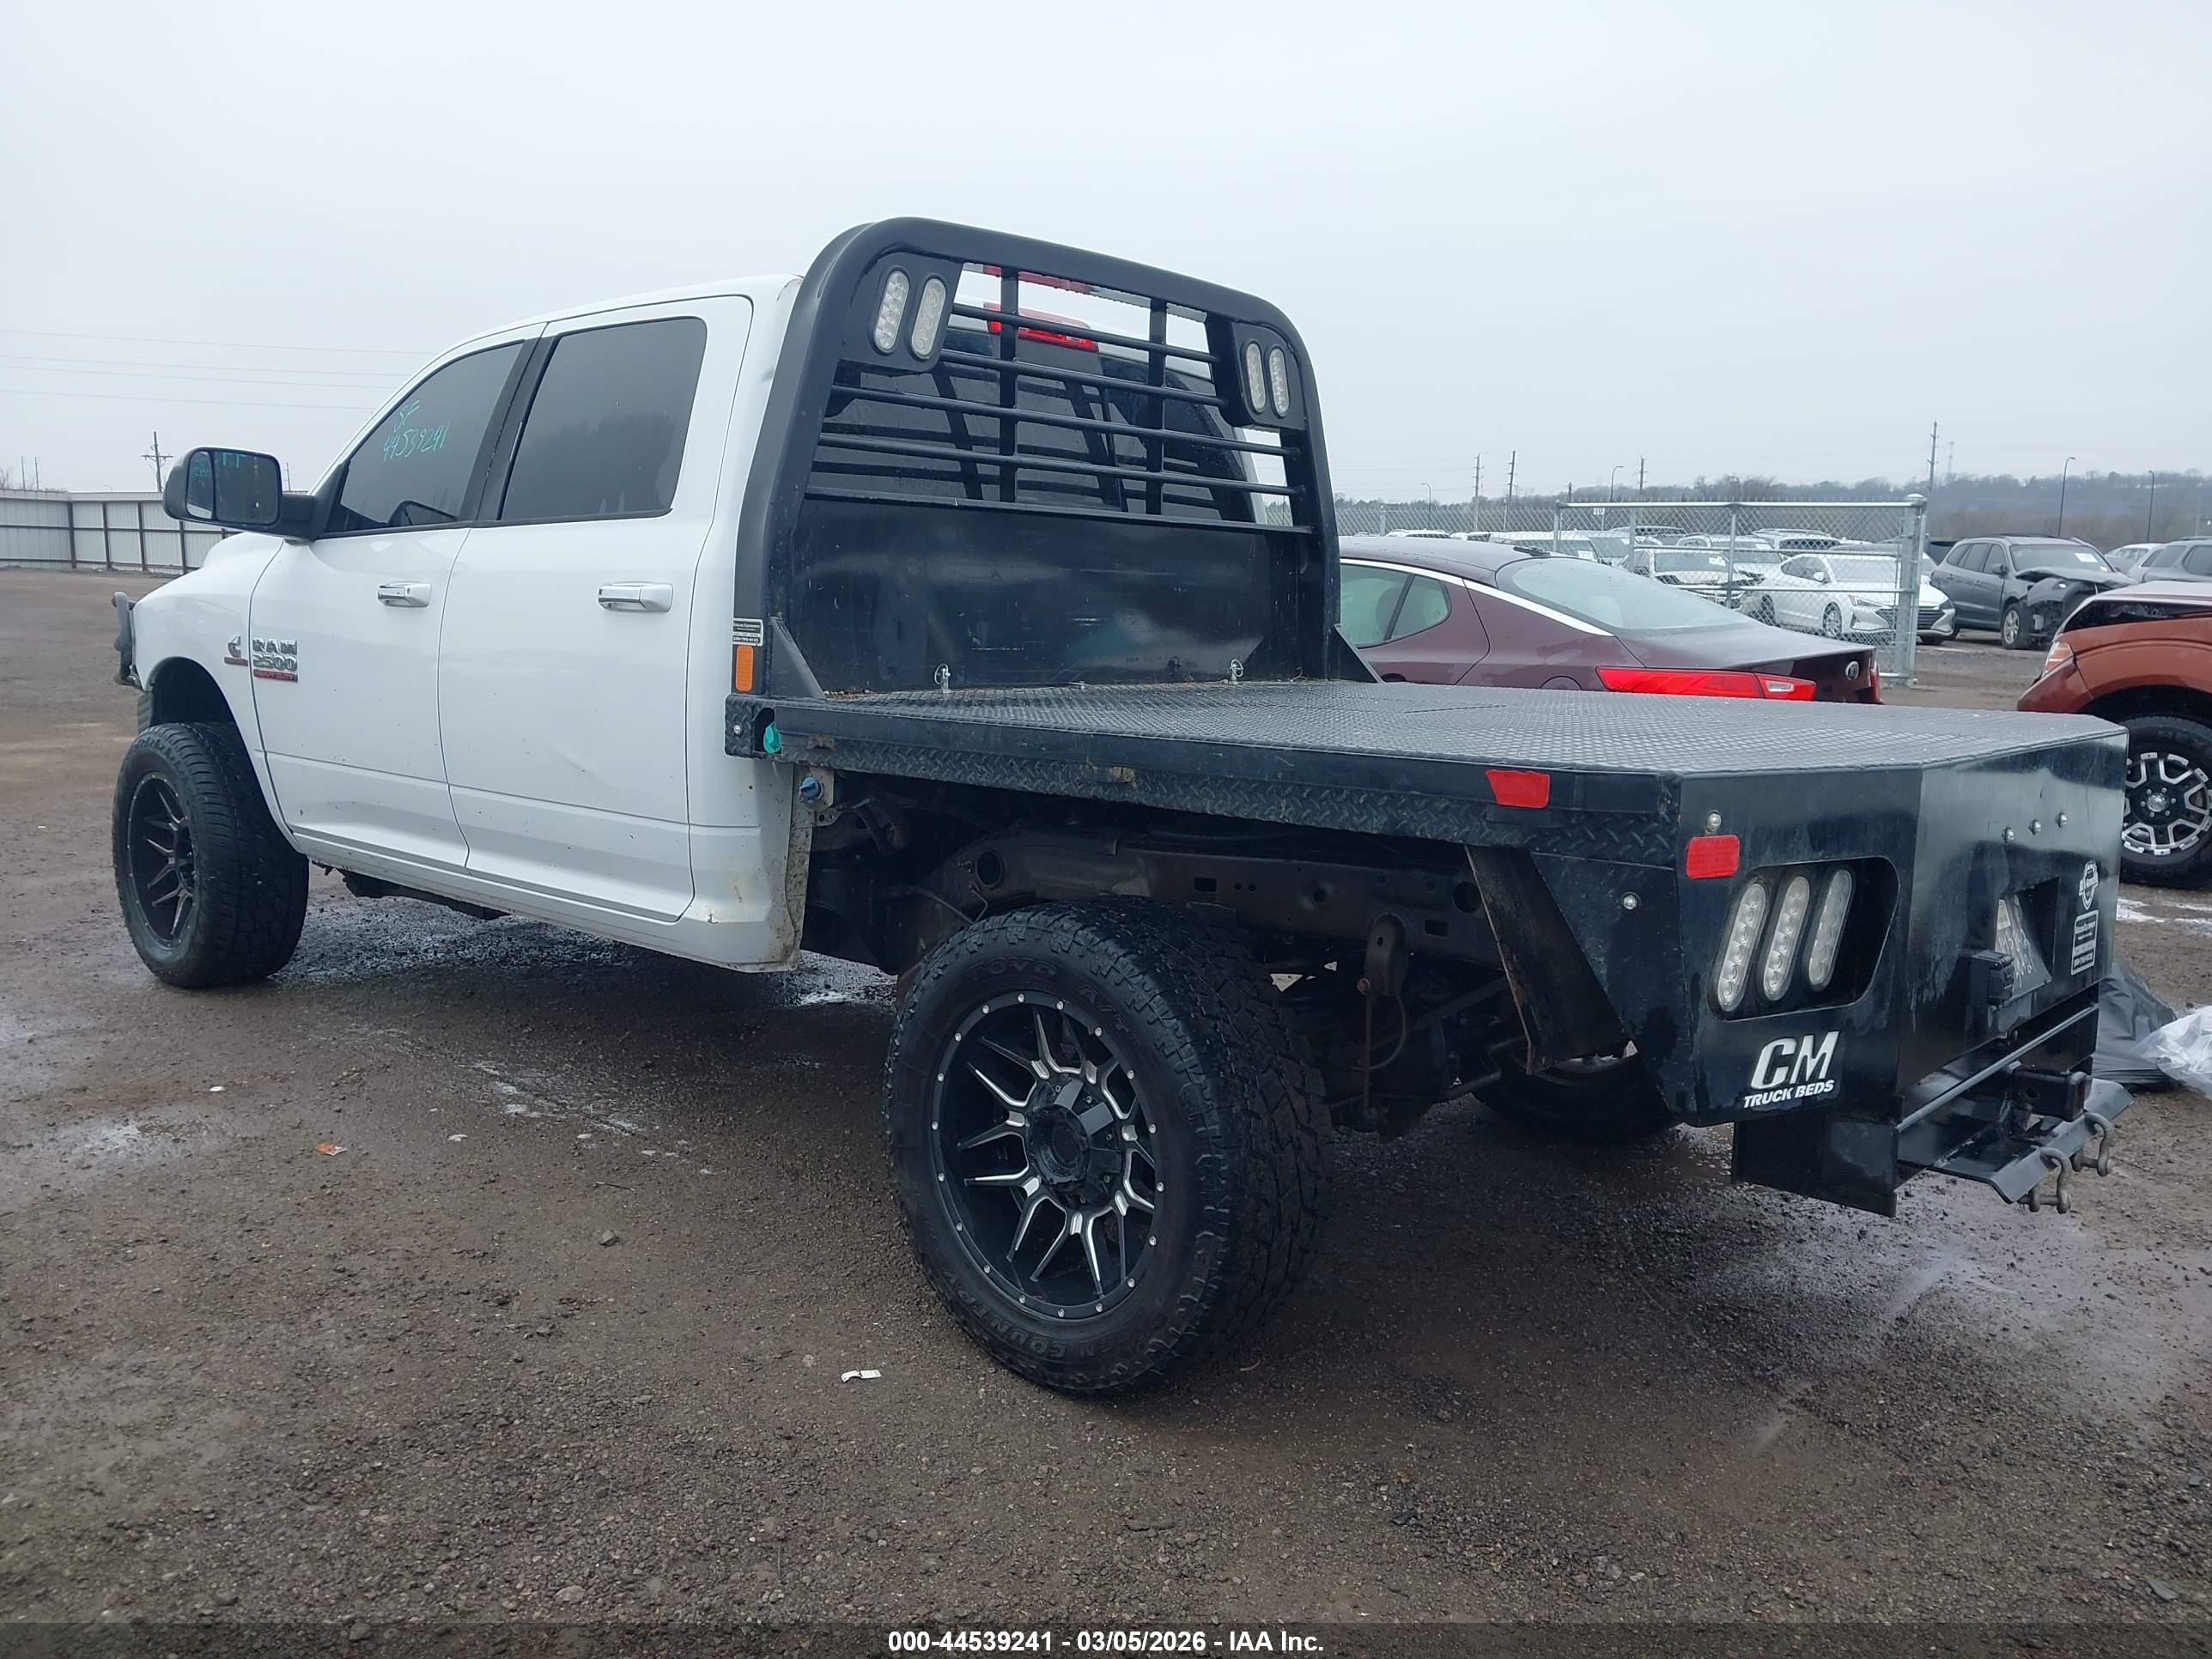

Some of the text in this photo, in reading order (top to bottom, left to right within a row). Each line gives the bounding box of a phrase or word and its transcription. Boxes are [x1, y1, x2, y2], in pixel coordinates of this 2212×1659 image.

[252, 638, 298, 655] RAM
[252, 652, 298, 672] 2500
[963, 956, 1059, 982] TOYO
[1750, 1030, 1839, 1090] CM
[1743, 1079, 1835, 1109] TRUCK BEDS
